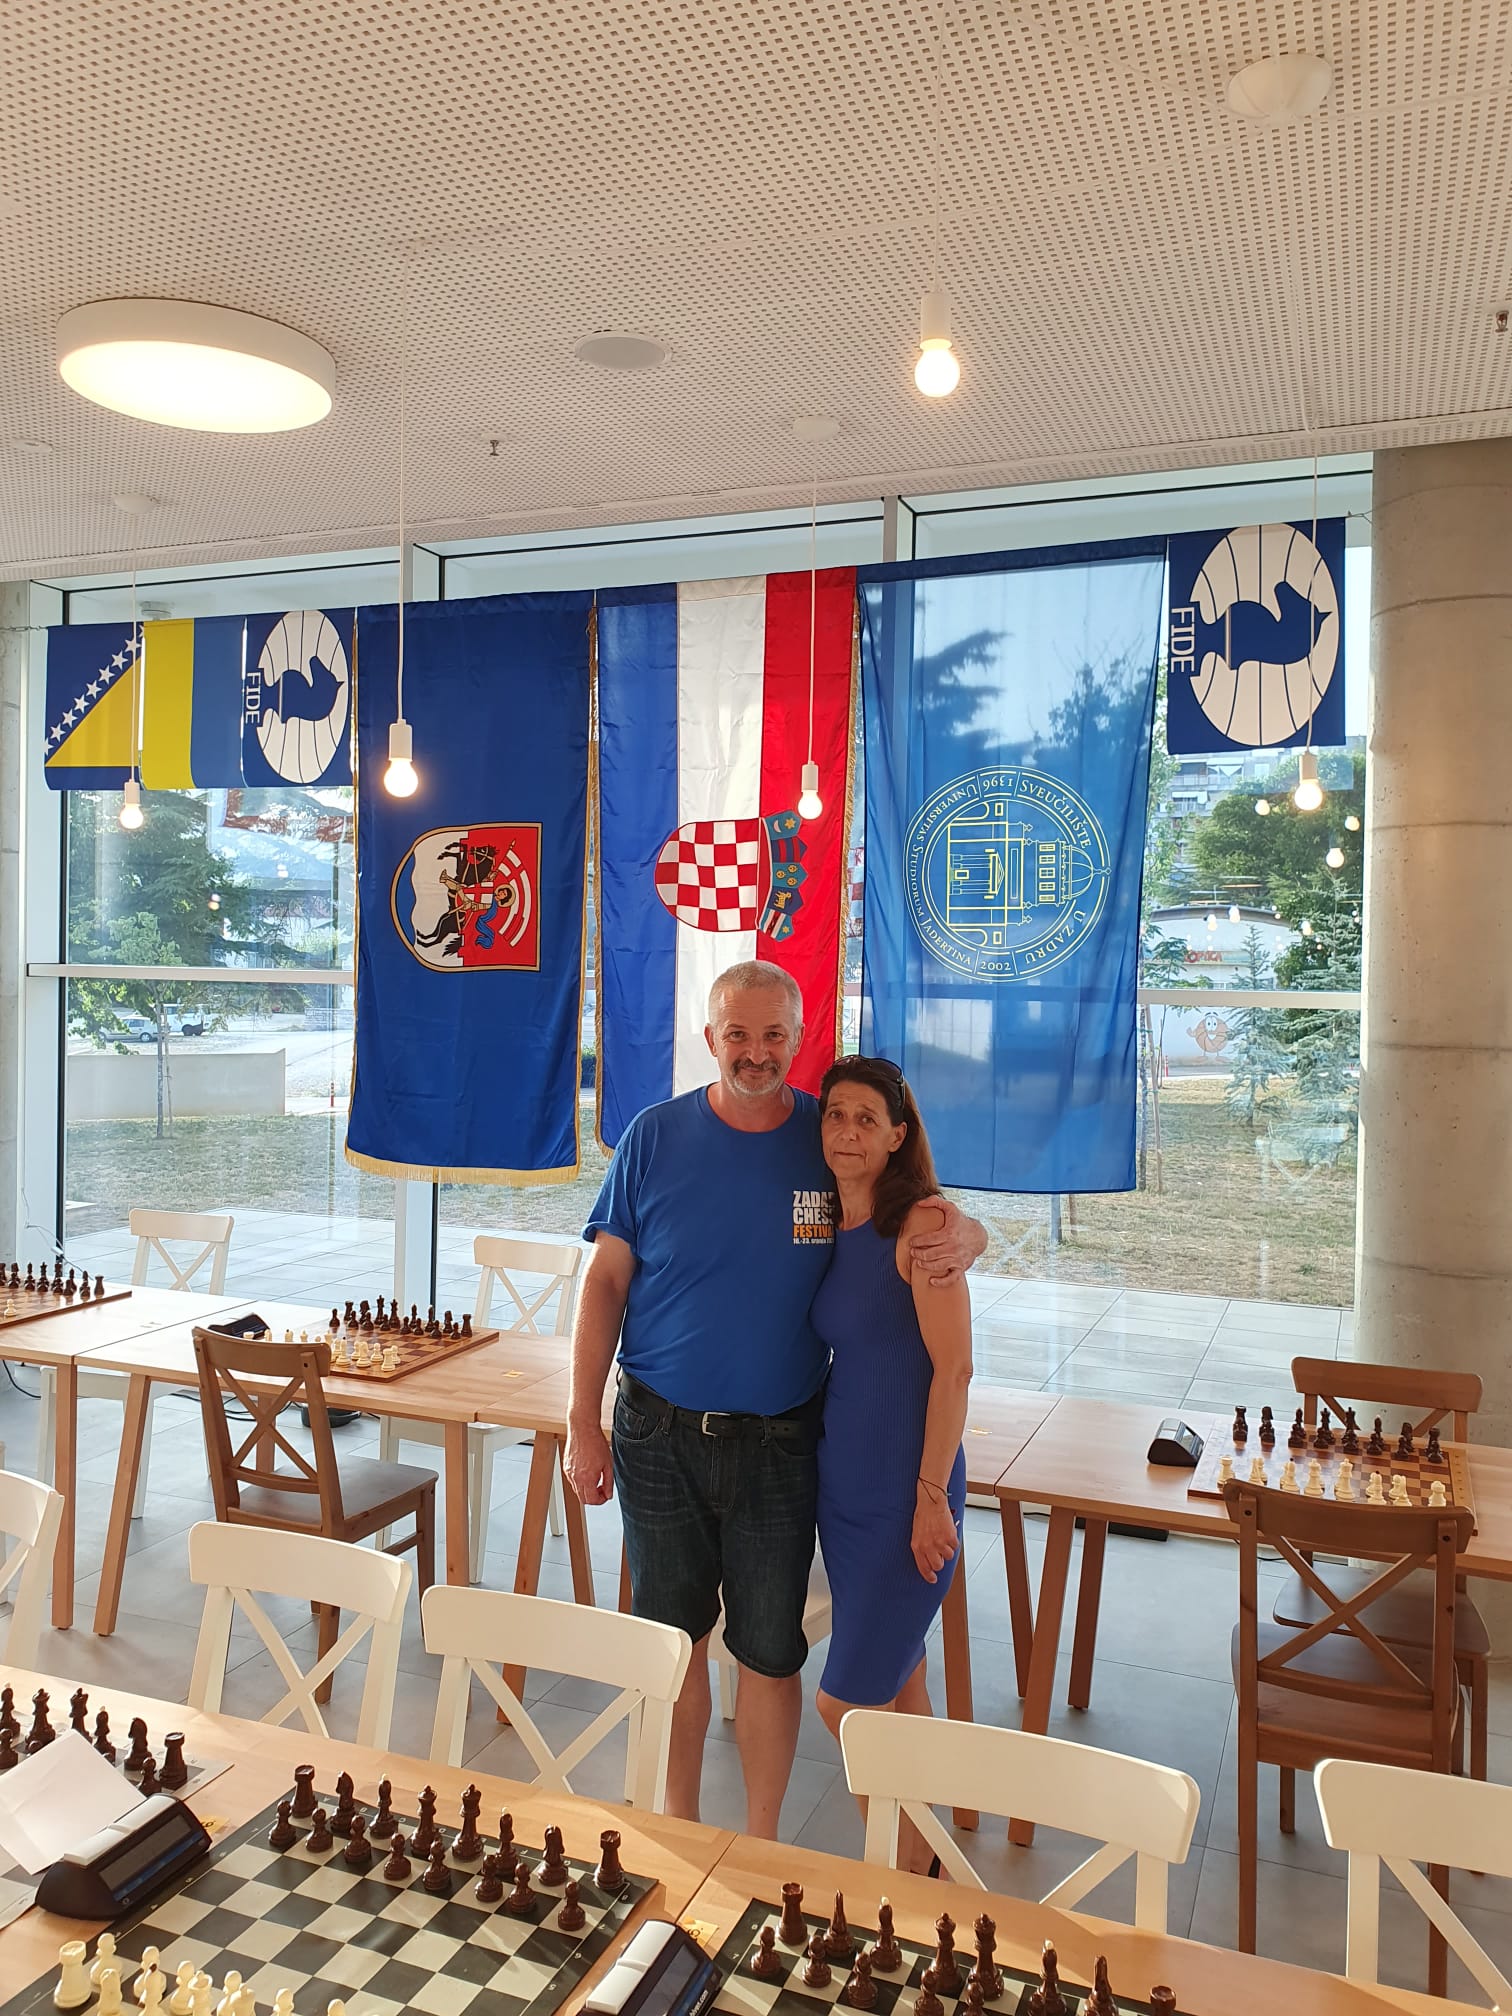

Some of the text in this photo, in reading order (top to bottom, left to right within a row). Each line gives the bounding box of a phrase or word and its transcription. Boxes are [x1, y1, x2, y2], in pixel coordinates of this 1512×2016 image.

[1171, 608, 1195, 673] FIDE
[246, 672, 261, 724] FIDE
[983, 775, 1013, 792] 1396
[912, 784, 978, 966] UNIVERSITAS STUDIORUM JADERTINA
[1020, 779, 1093, 964] SVEUČILIŠTE U ZADRU
[981, 960, 1011, 971] 2002
[793, 1225, 833, 1237] FESTIVA
